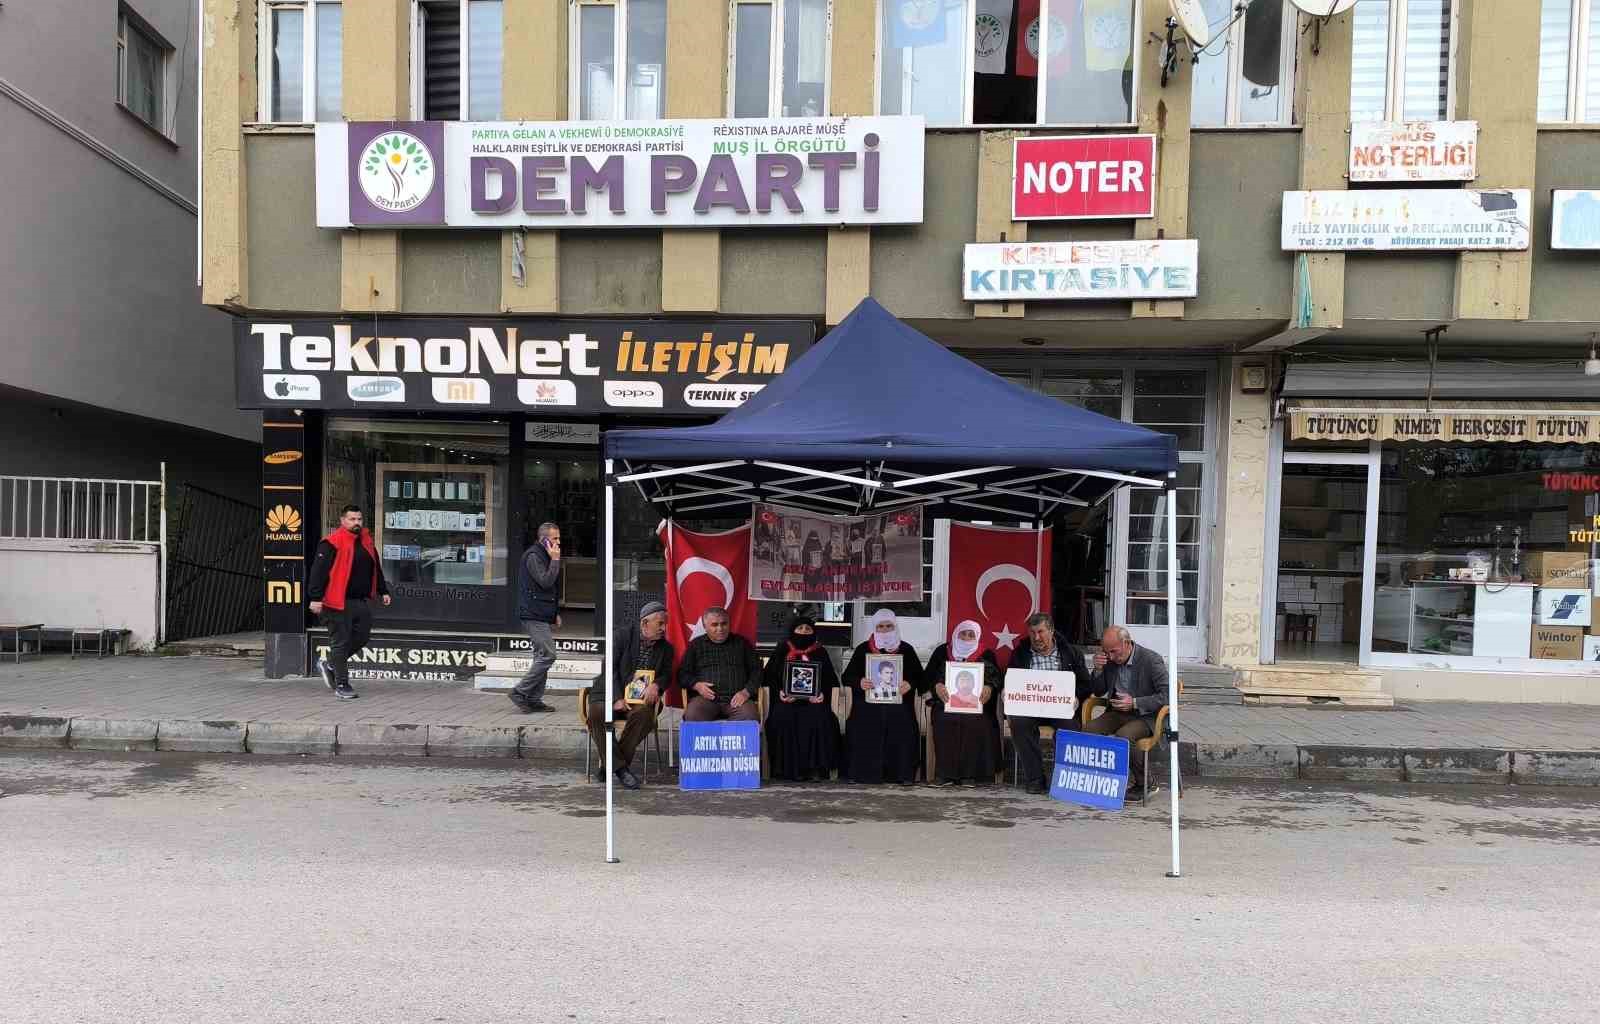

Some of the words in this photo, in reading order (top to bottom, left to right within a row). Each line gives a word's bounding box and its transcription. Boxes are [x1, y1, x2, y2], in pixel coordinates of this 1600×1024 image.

[472, 129, 509, 139] PARTIYA
[512, 129, 546, 139] GELAN
[472, 143, 529, 153] HALKLARIN
[531, 141, 568, 155] EŞİTLİK
[570, 143, 583, 153] VE
[585, 141, 642, 152] DEMOKRASİ
[646, 140, 684, 152] PARTİSİ
[713, 141, 749, 156] MUŞ
[754, 139, 769, 153] İL
[774, 137, 846, 153] ÖRGÜTÜ
[471, 155, 626, 215] DEM
[650, 132, 880, 214] PARTİ
[1023, 160, 1145, 194] NOTER
[250, 323, 600, 376] TeknoNet
[616, 330, 790, 382] İLETİŞİM
[687, 388, 736, 401] TEKNİK
[1307, 416, 1378, 434] TÜTÜNCÜ
[1394, 416, 1441, 435] NİMET
[1452, 416, 1528, 439] HERÇESİT
[1536, 416, 1588, 436] TÜTÜN
[265, 533, 302, 541] HUAWEI
[348, 669, 401, 680] TELEFON
[410, 671, 457, 681] TABLET
[1025, 683, 1053, 692] EVLAT
[694, 736, 718, 751] ARTIK
[718, 735, 741, 751] YETER
[680, 756, 732, 773] YAKAMIZDAN
[733, 753, 760, 776] DÜŞÜN
[1064, 744, 1116, 770] ANNELER
[1057, 769, 1120, 798] DİRENİYOR
